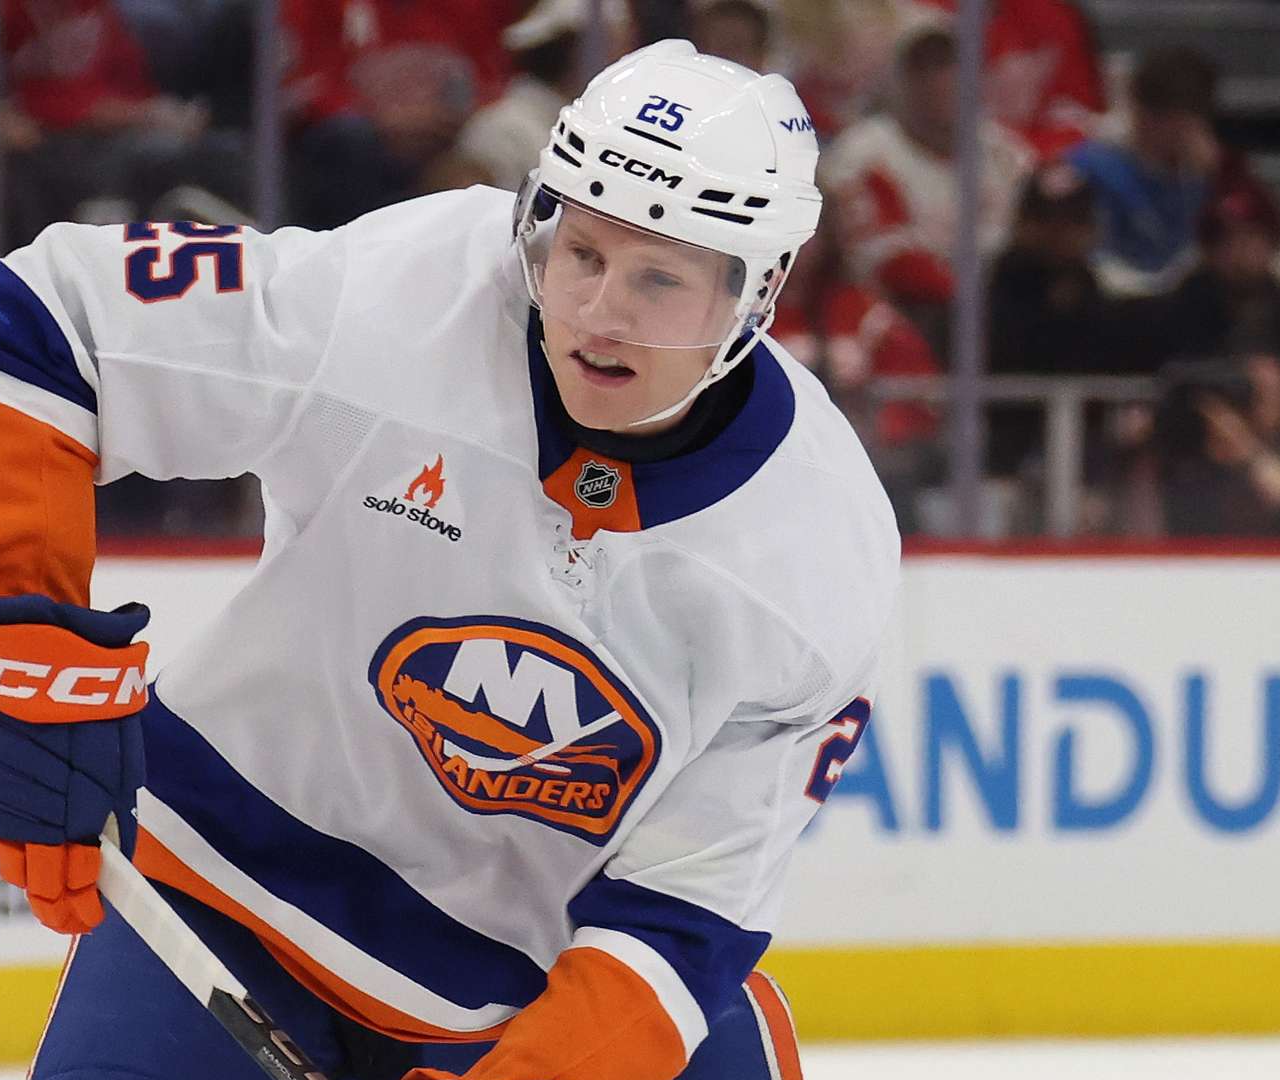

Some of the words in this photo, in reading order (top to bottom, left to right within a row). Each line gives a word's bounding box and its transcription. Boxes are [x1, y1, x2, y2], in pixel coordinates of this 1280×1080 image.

[636, 95, 692, 132] 25
[599, 149, 683, 189] CCM
[582, 478, 610, 494] NHL
[363, 497, 406, 515] solo
[407, 508, 461, 541] stove
